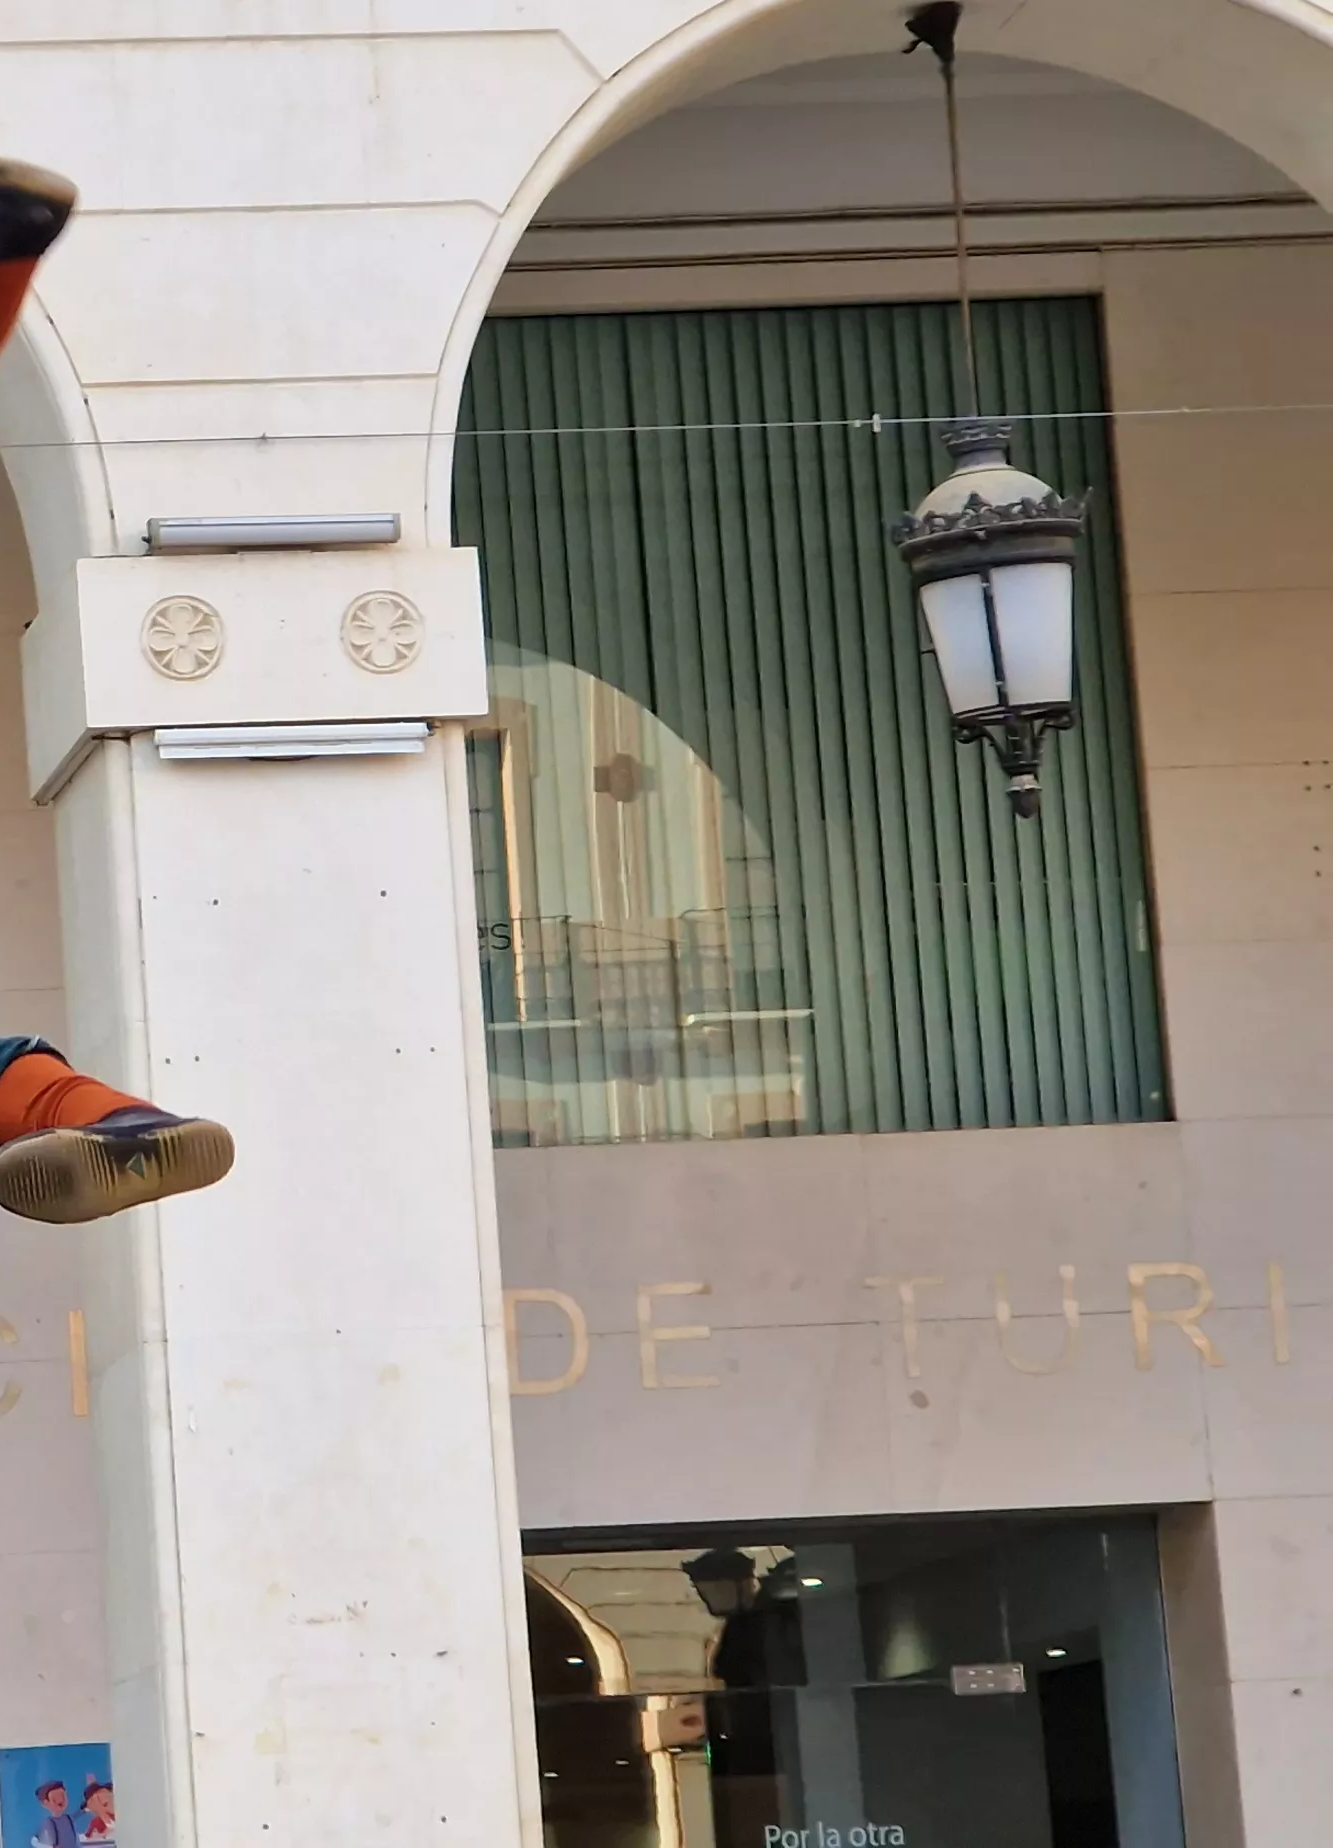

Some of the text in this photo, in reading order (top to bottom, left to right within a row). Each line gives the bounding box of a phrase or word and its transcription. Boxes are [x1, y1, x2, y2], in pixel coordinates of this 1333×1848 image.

[503, 1281, 721, 1396] DE
[764, 1821, 906, 1848] Por la otra
